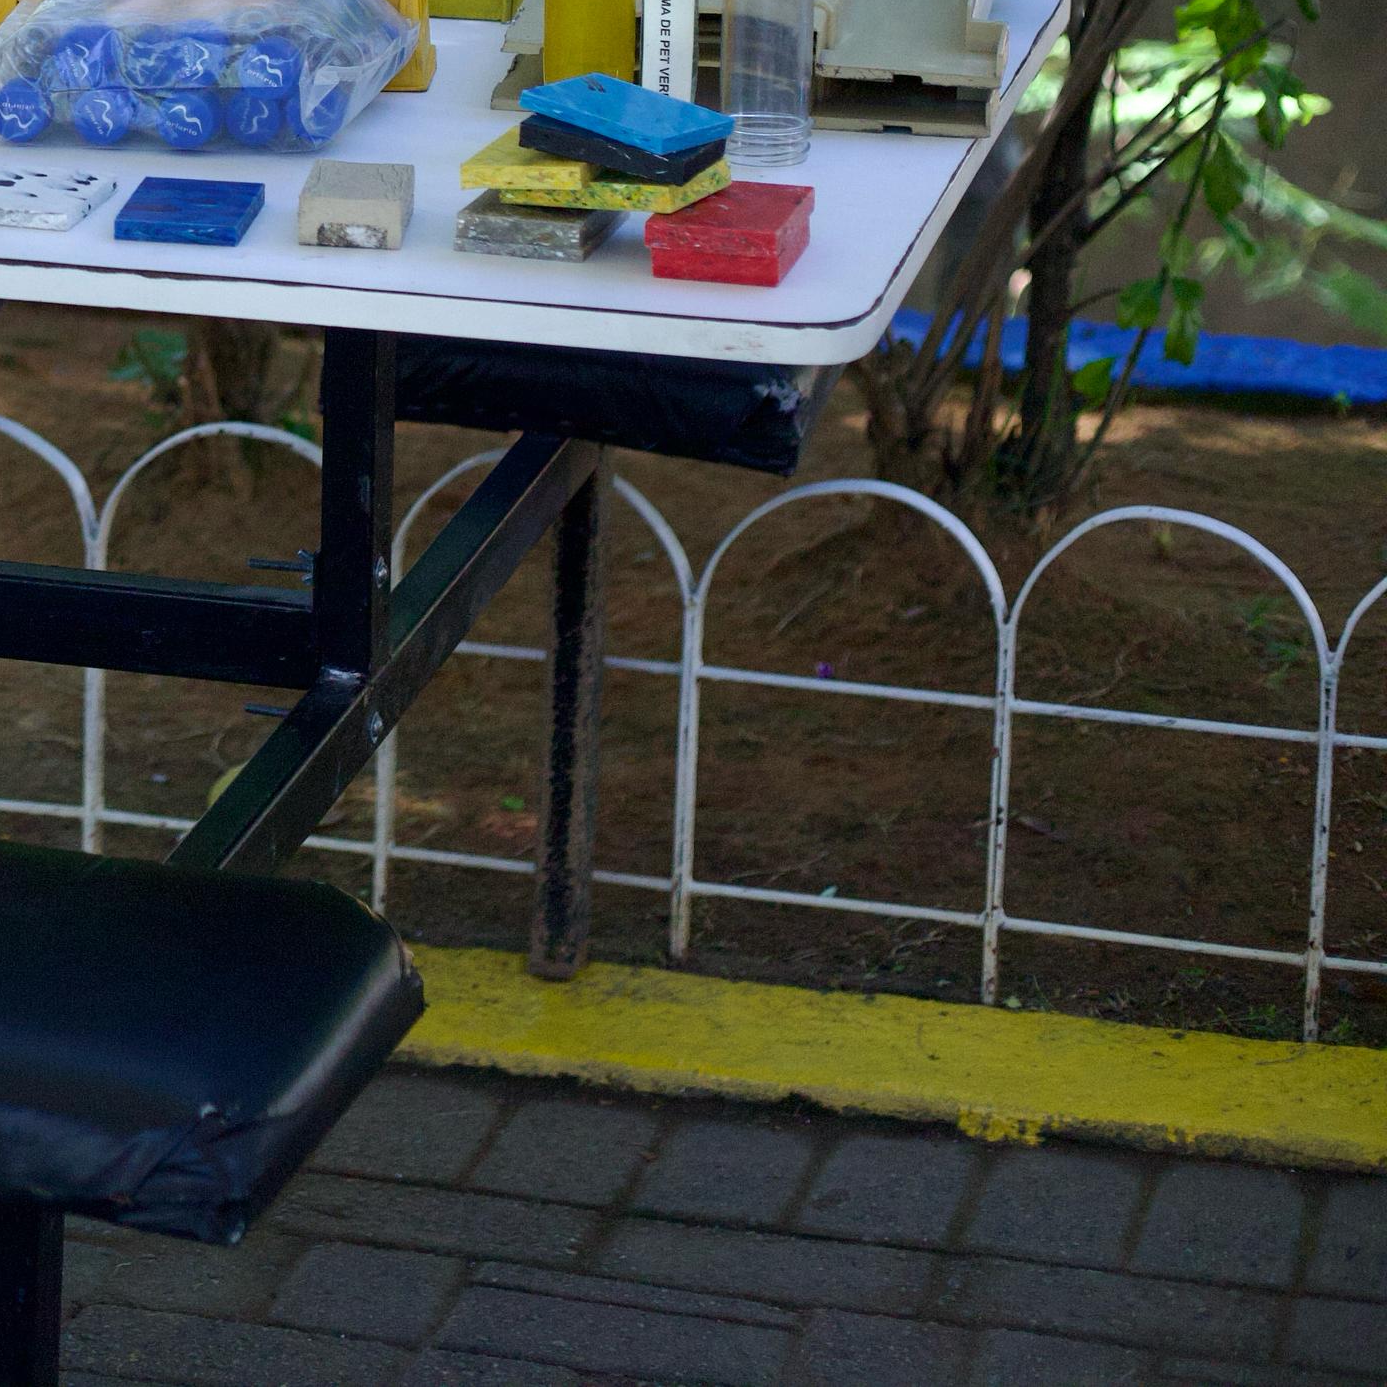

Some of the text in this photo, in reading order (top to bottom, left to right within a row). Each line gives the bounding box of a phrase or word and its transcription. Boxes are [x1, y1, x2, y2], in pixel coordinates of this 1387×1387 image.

[660, 19, 671, 36] DE
[659, 40, 670, 65] PET
[658, 67, 669, 96] VER
